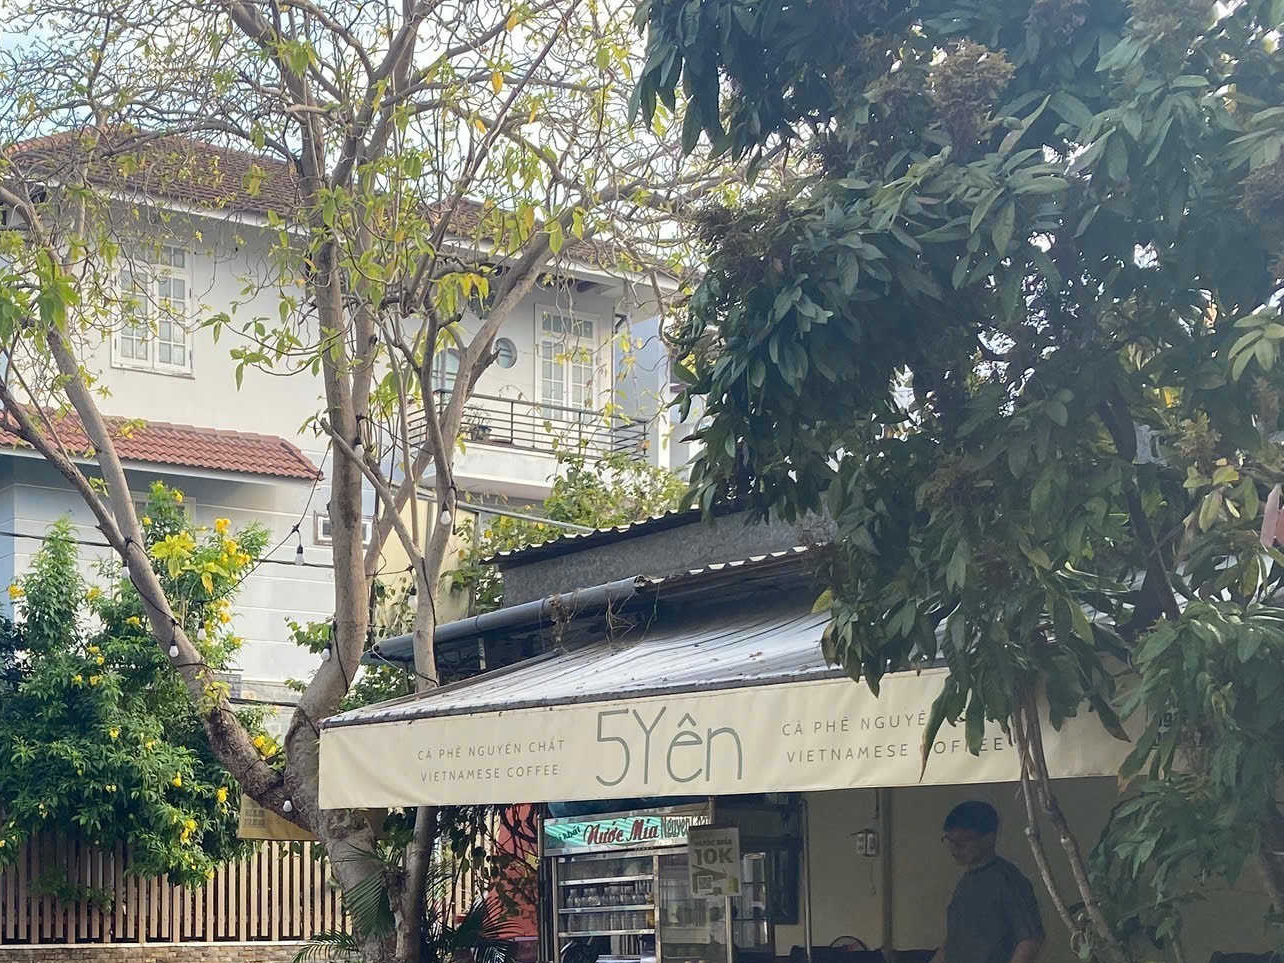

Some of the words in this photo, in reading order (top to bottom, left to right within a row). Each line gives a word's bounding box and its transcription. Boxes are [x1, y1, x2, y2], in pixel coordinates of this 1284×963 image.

[596, 706, 743, 786] 5Yên
[787, 743, 909, 763] VIETNAMESE
[420, 767, 500, 782] VIETNAMESE
[506, 764, 559, 778] COFFEE
[694, 847, 734, 866] 10K
